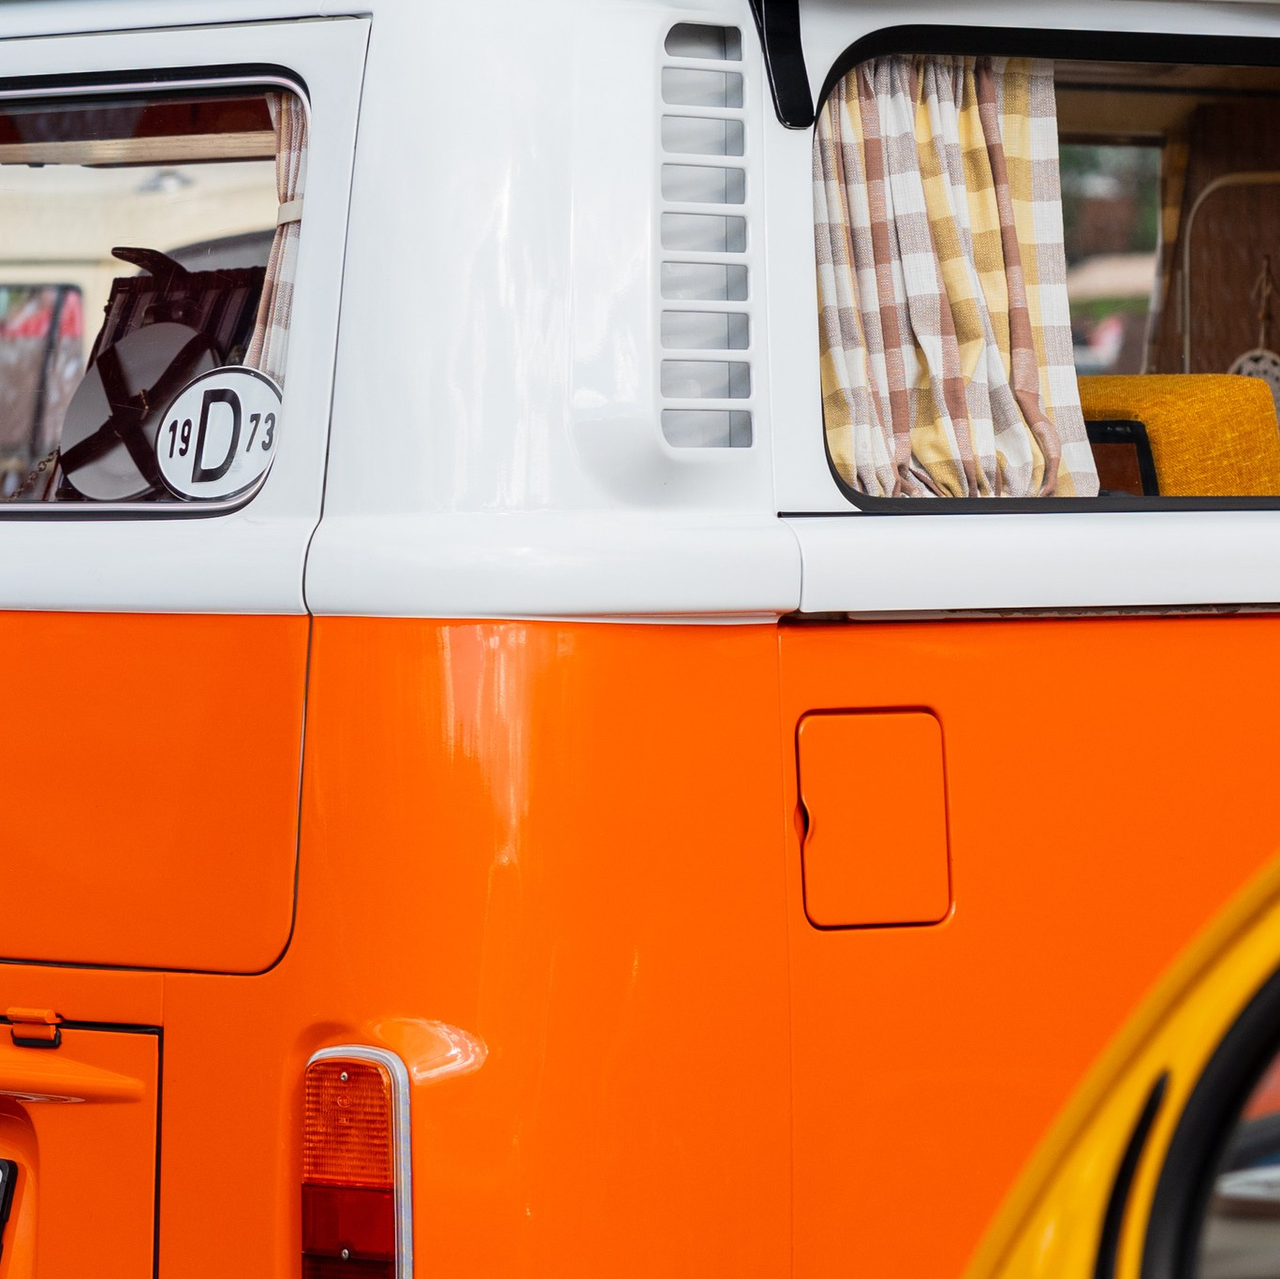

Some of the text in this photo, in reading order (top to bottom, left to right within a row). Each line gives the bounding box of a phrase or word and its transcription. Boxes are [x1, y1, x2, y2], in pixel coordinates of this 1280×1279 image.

[169, 388, 276, 483] 19 D 73
